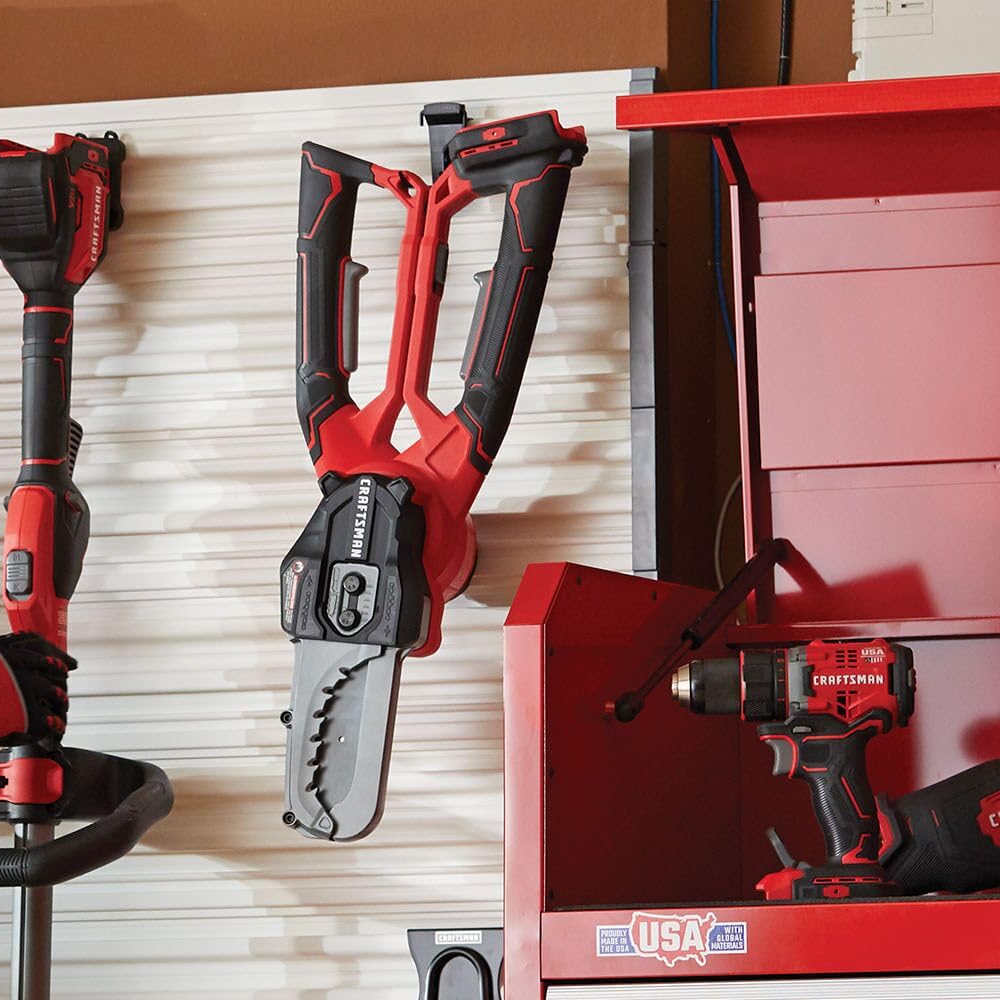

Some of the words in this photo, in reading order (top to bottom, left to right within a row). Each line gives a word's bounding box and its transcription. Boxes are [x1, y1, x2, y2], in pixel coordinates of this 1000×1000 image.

[91, 186, 102, 262] CRAFTSMAN
[350, 478, 371, 558] CRAFTSMAN
[861, 648, 884, 656] USA
[813, 674, 884, 686] CRAFTSMAN
[600, 929, 628, 938] PROUDLY
[724, 926, 743, 934] WITH
[639, 920, 705, 952] USA
[716, 934, 744, 942] GLOBAL
[600, 937, 619, 945] MADE
[620, 937, 627, 945] IN
[600, 945, 614, 953] THE
[711, 942, 744, 950] MATERIALS
